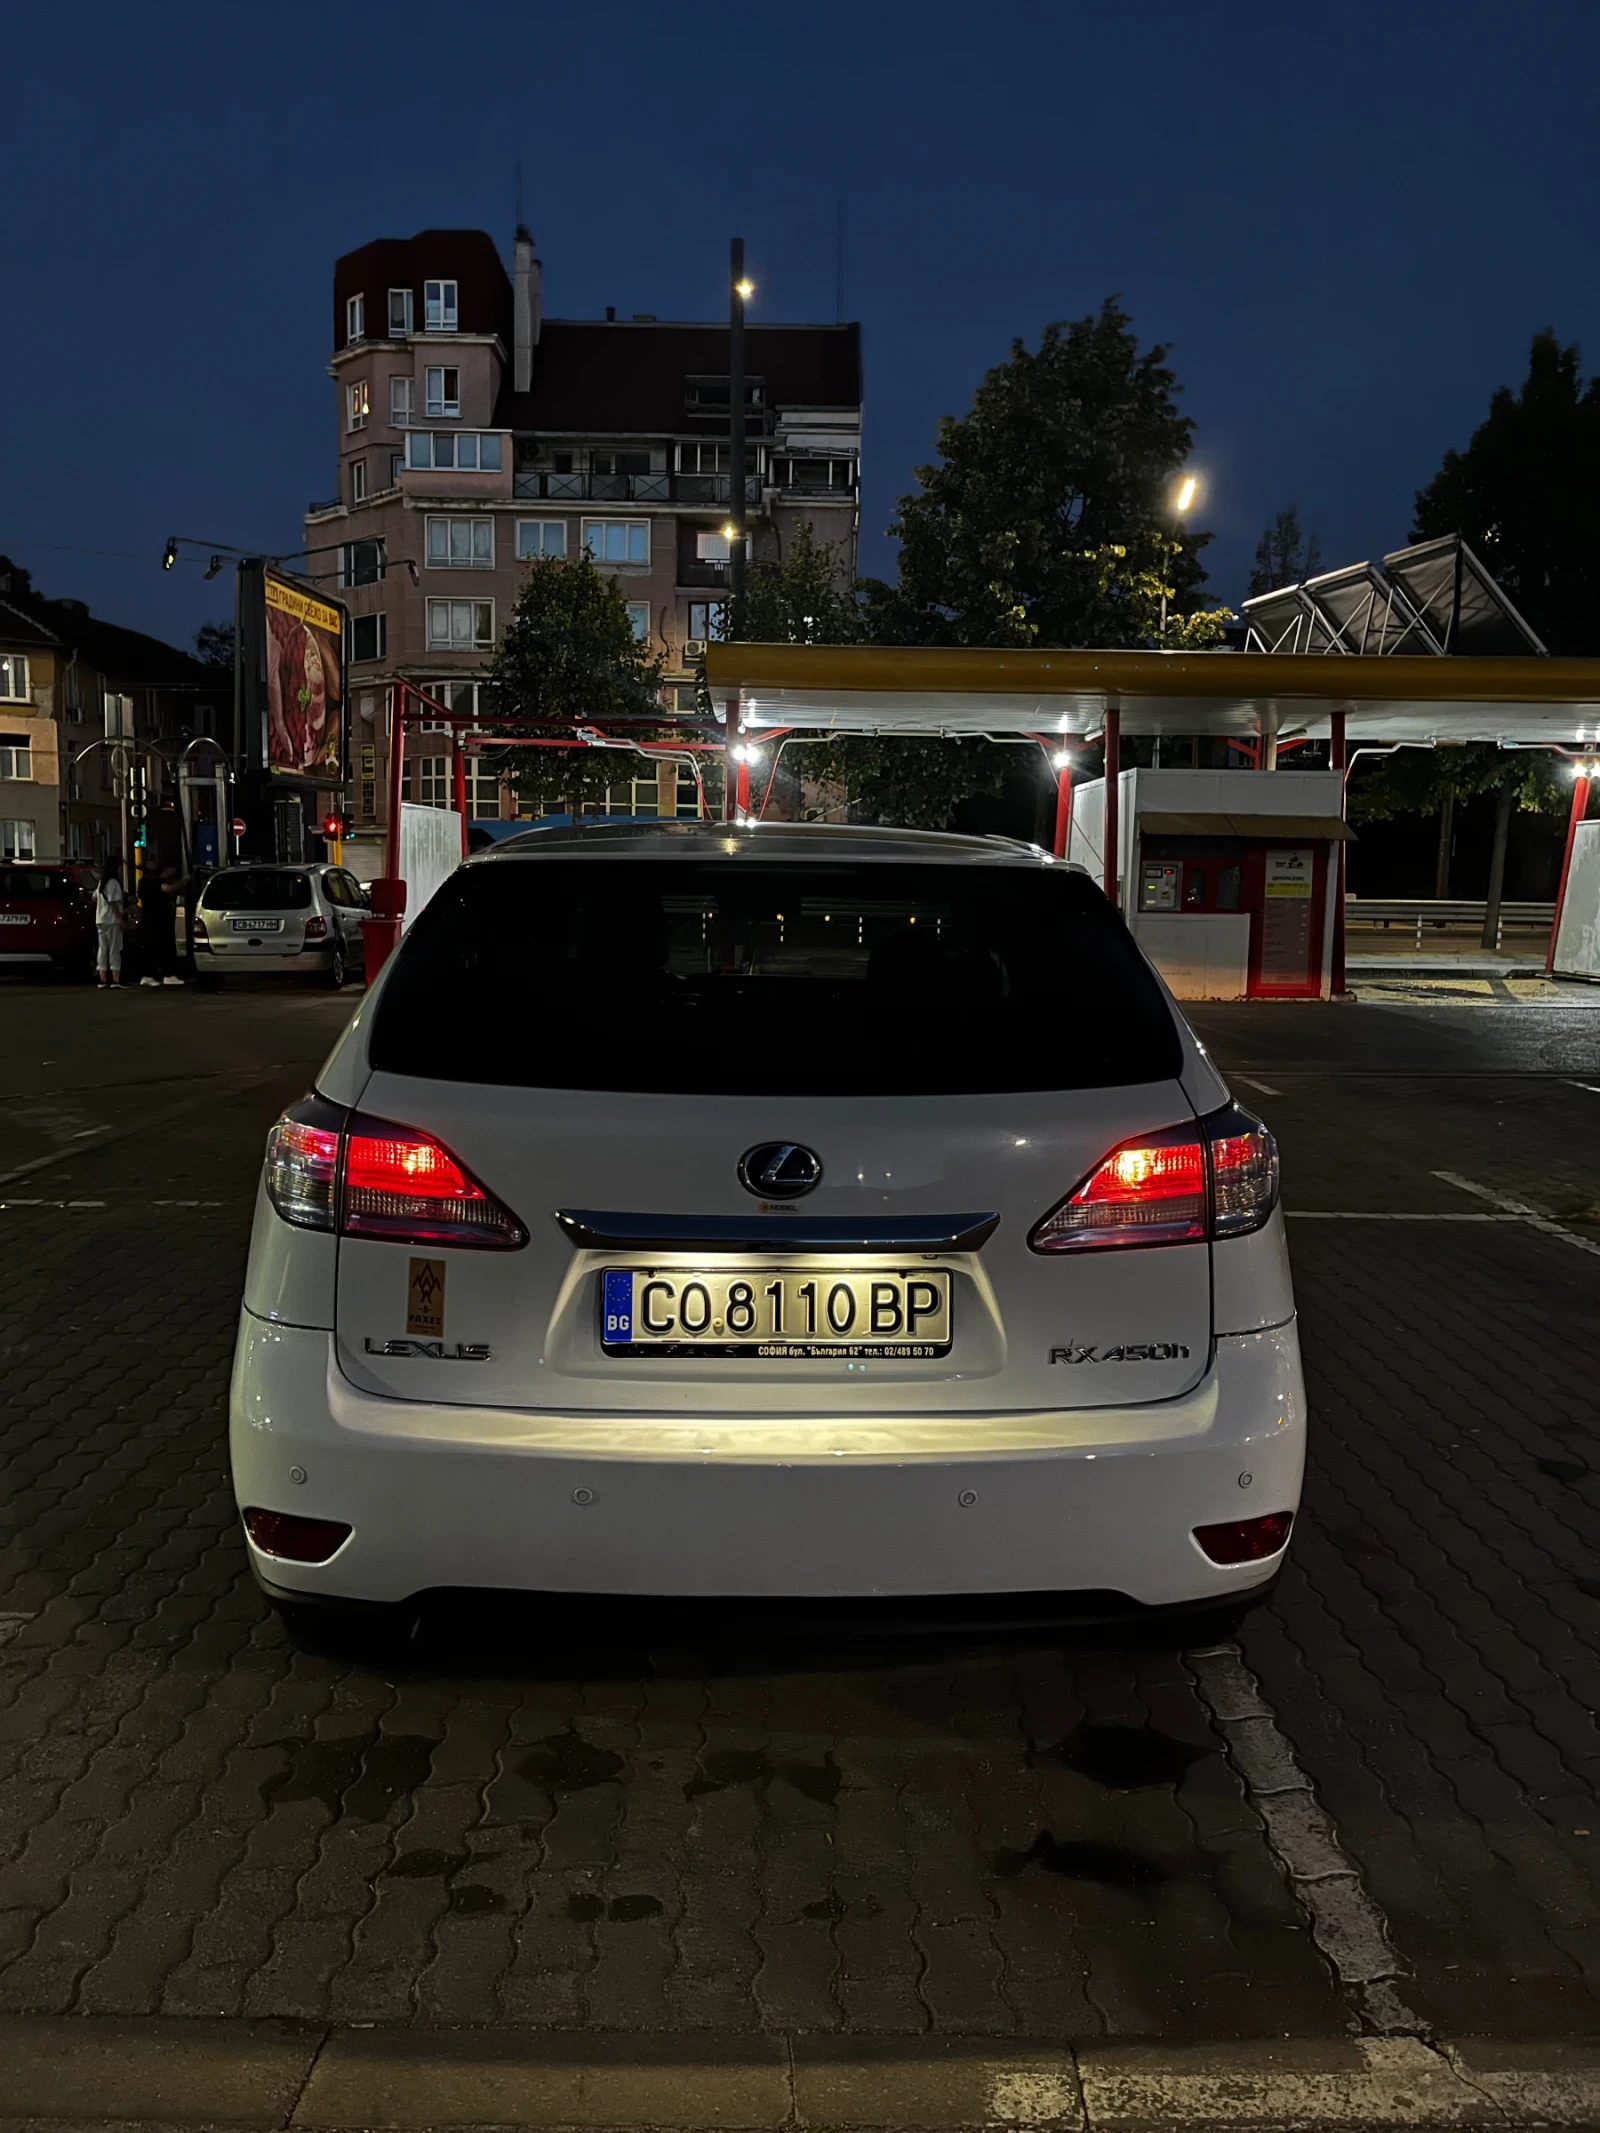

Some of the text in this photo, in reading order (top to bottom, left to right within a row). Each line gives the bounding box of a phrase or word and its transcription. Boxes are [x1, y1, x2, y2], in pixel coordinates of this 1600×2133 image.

[607, 1315, 629, 1331] BG
[365, 1338, 491, 1361] LEXUS
[758, 1346, 787, 1356] СОФИЯ
[788, 1346, 806, 1357] бул.
[864, 1347, 882, 1356] тел.:
[884, 1346, 911, 1357] 02/489
[912, 1347, 923, 1356] 50
[924, 1347, 934, 1356] 70
